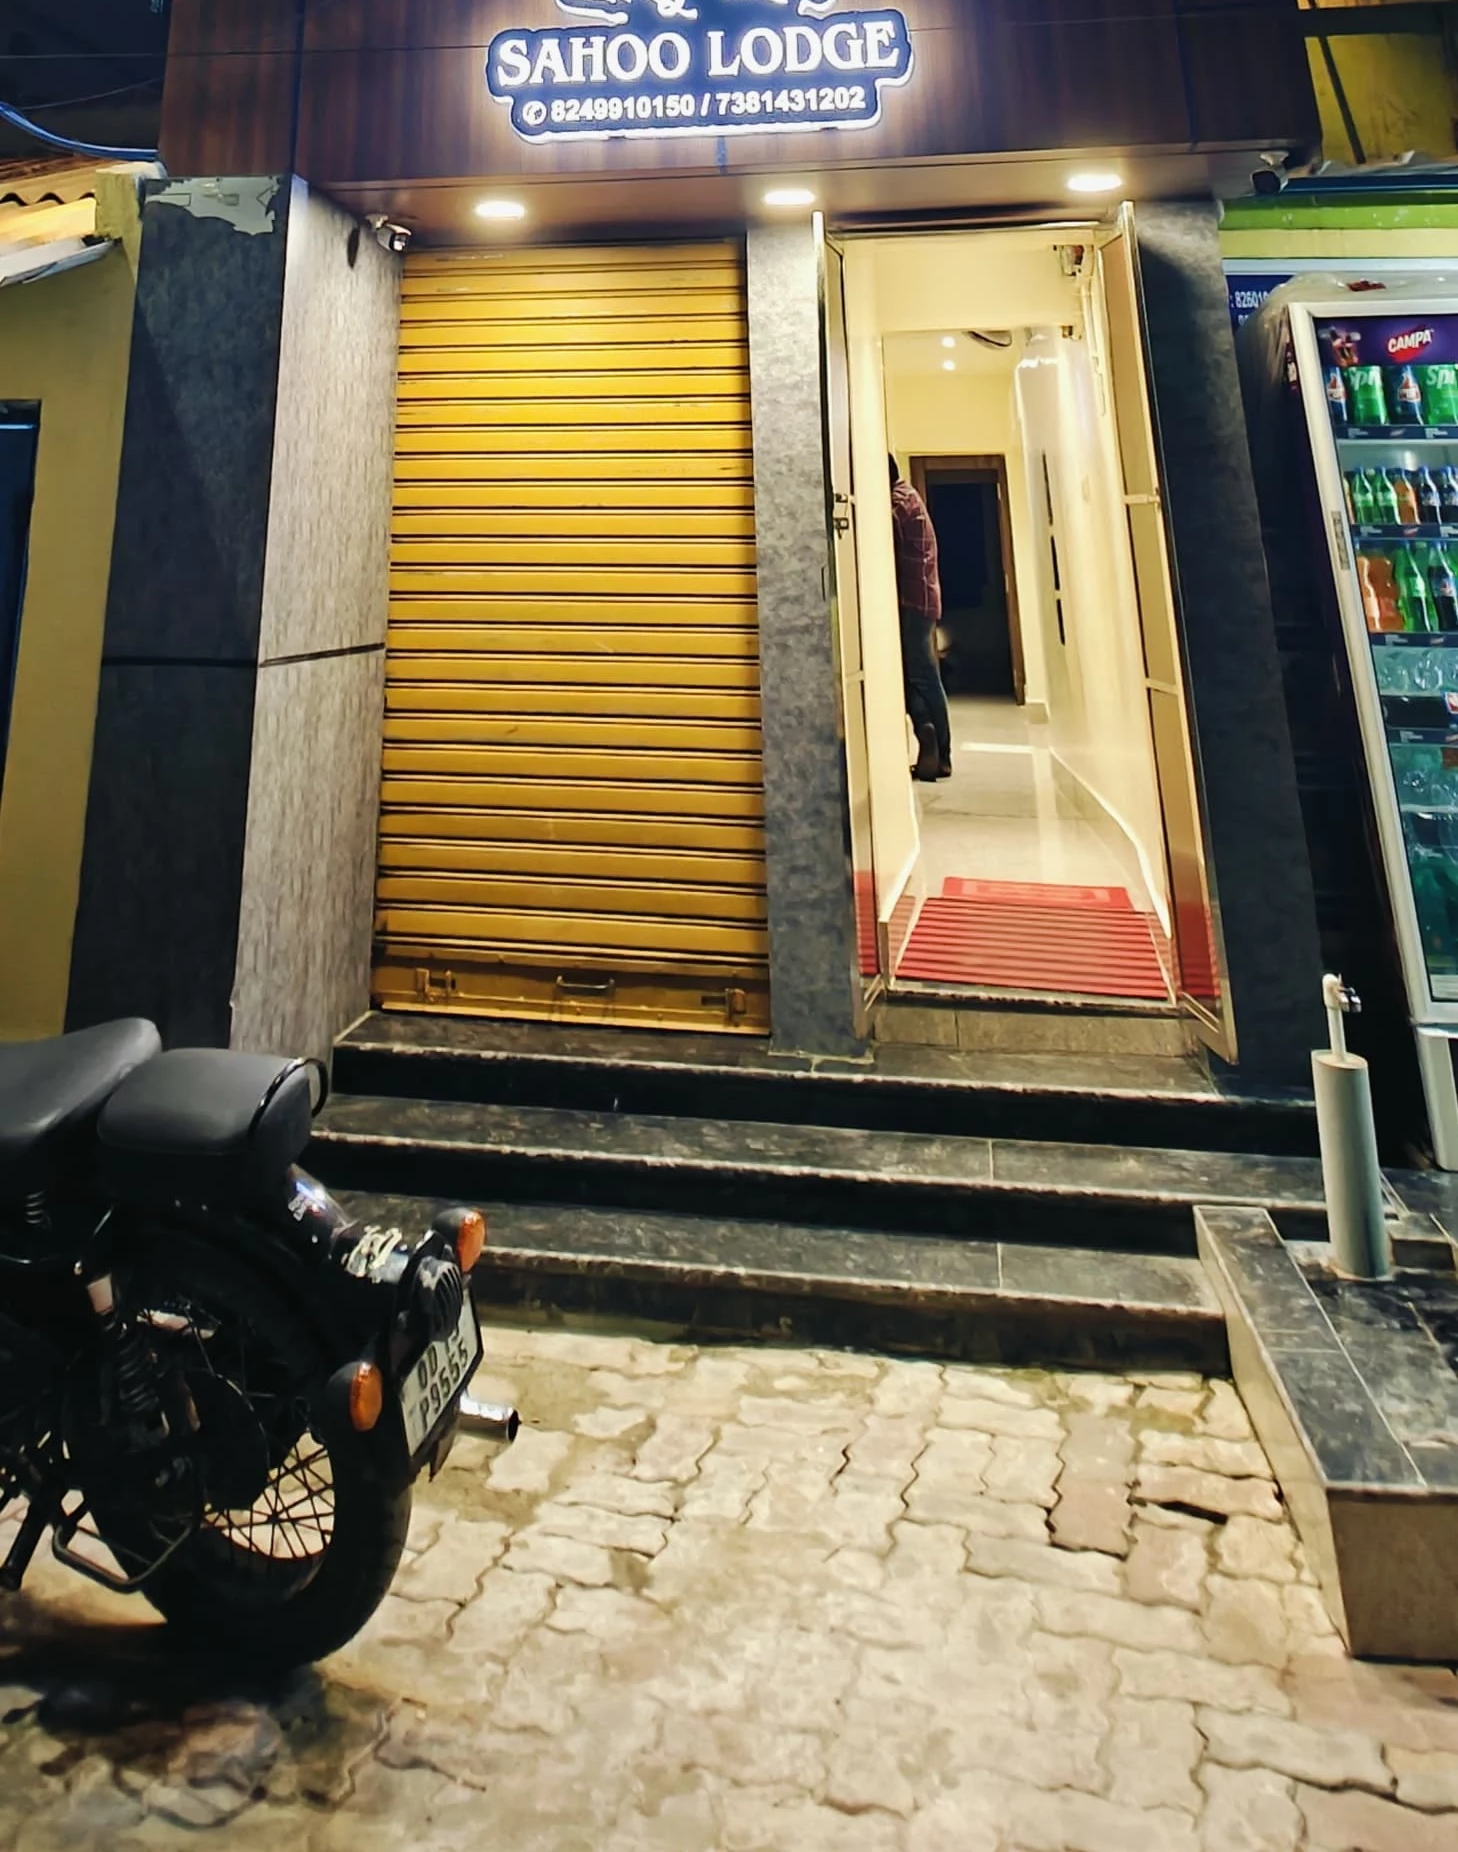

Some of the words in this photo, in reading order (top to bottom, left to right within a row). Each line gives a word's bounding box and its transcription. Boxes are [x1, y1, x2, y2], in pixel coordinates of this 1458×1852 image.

[497, 32, 691, 87] SAHOO
[708, 20, 900, 78] LODGE
[550, 93, 695, 122] 8249910150
[716, 85, 866, 116] 7381431202
[1387, 329, 1432, 353] CAMPA
